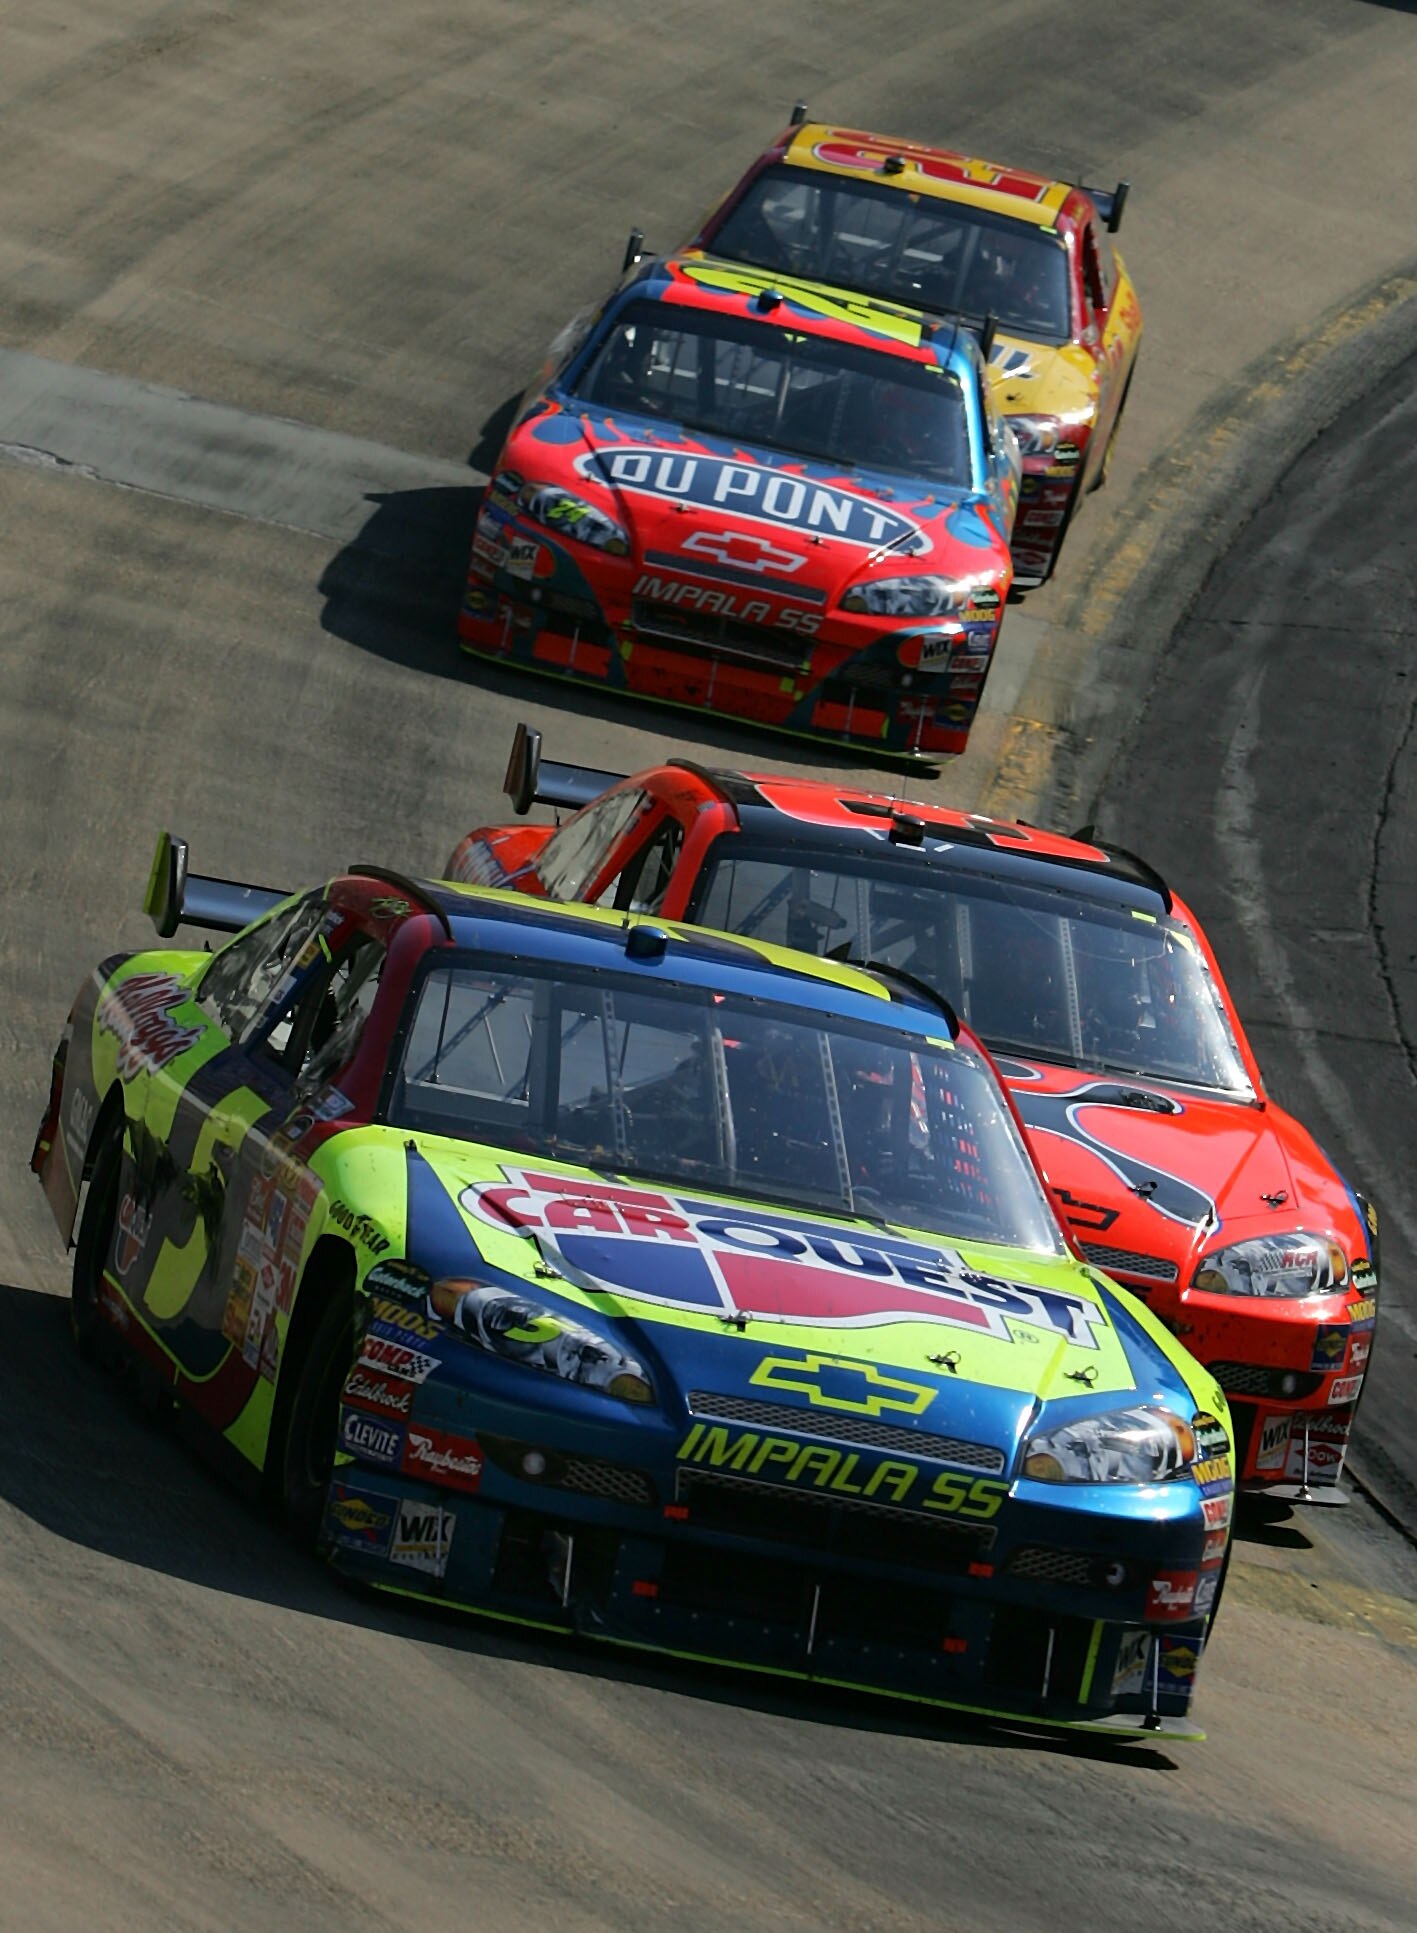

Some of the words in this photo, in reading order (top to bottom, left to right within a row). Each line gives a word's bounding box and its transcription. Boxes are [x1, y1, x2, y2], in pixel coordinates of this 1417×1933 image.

[610, 454, 696, 493] DU
[713, 460, 901, 539] PONT
[632, 575, 773, 625] IMPALA
[774, 608, 827, 636] SS
[329, 1200, 391, 1256] GOODYEAR
[477, 1186, 1086, 1340] CARQUEST
[371, 1296, 446, 1340] MOOG
[361, 1338, 414, 1368] COMP
[345, 1373, 411, 1414] Edelbrock
[344, 1414, 400, 1456] CLEVITE
[408, 1433, 482, 1475] Raybestos
[1262, 1420, 1290, 1451] WIX
[677, 1424, 918, 1499] IMPALA
[924, 1472, 1010, 1518] SS
[401, 1515, 450, 1542] WIX
